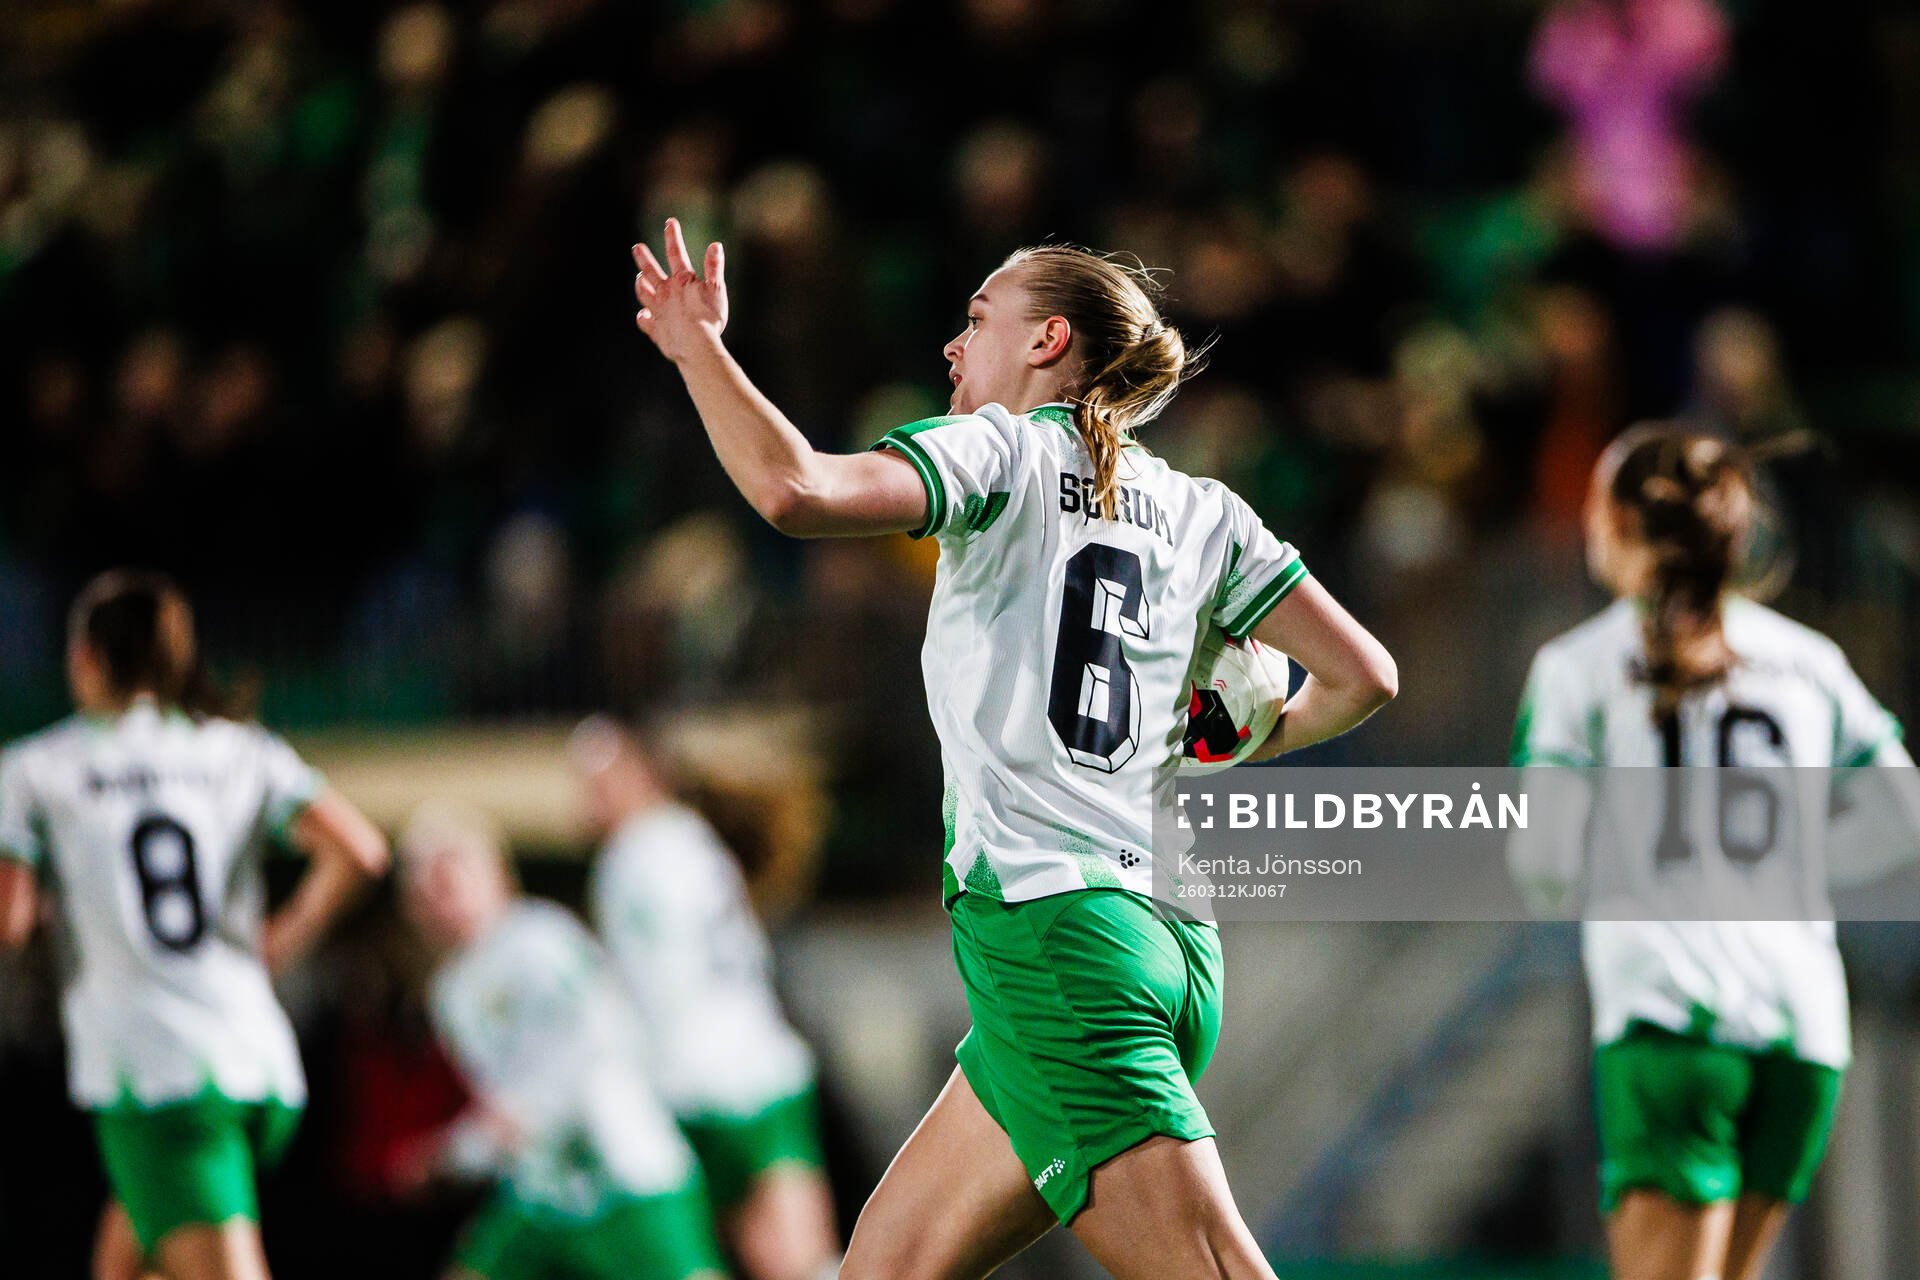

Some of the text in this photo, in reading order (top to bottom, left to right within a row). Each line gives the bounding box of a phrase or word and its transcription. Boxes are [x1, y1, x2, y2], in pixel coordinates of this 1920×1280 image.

[1047, 541, 1150, 774] 6
[1652, 705, 1790, 866] 16
[131, 813, 206, 952] 8
[1033, 1164, 1055, 1191] RAFT
